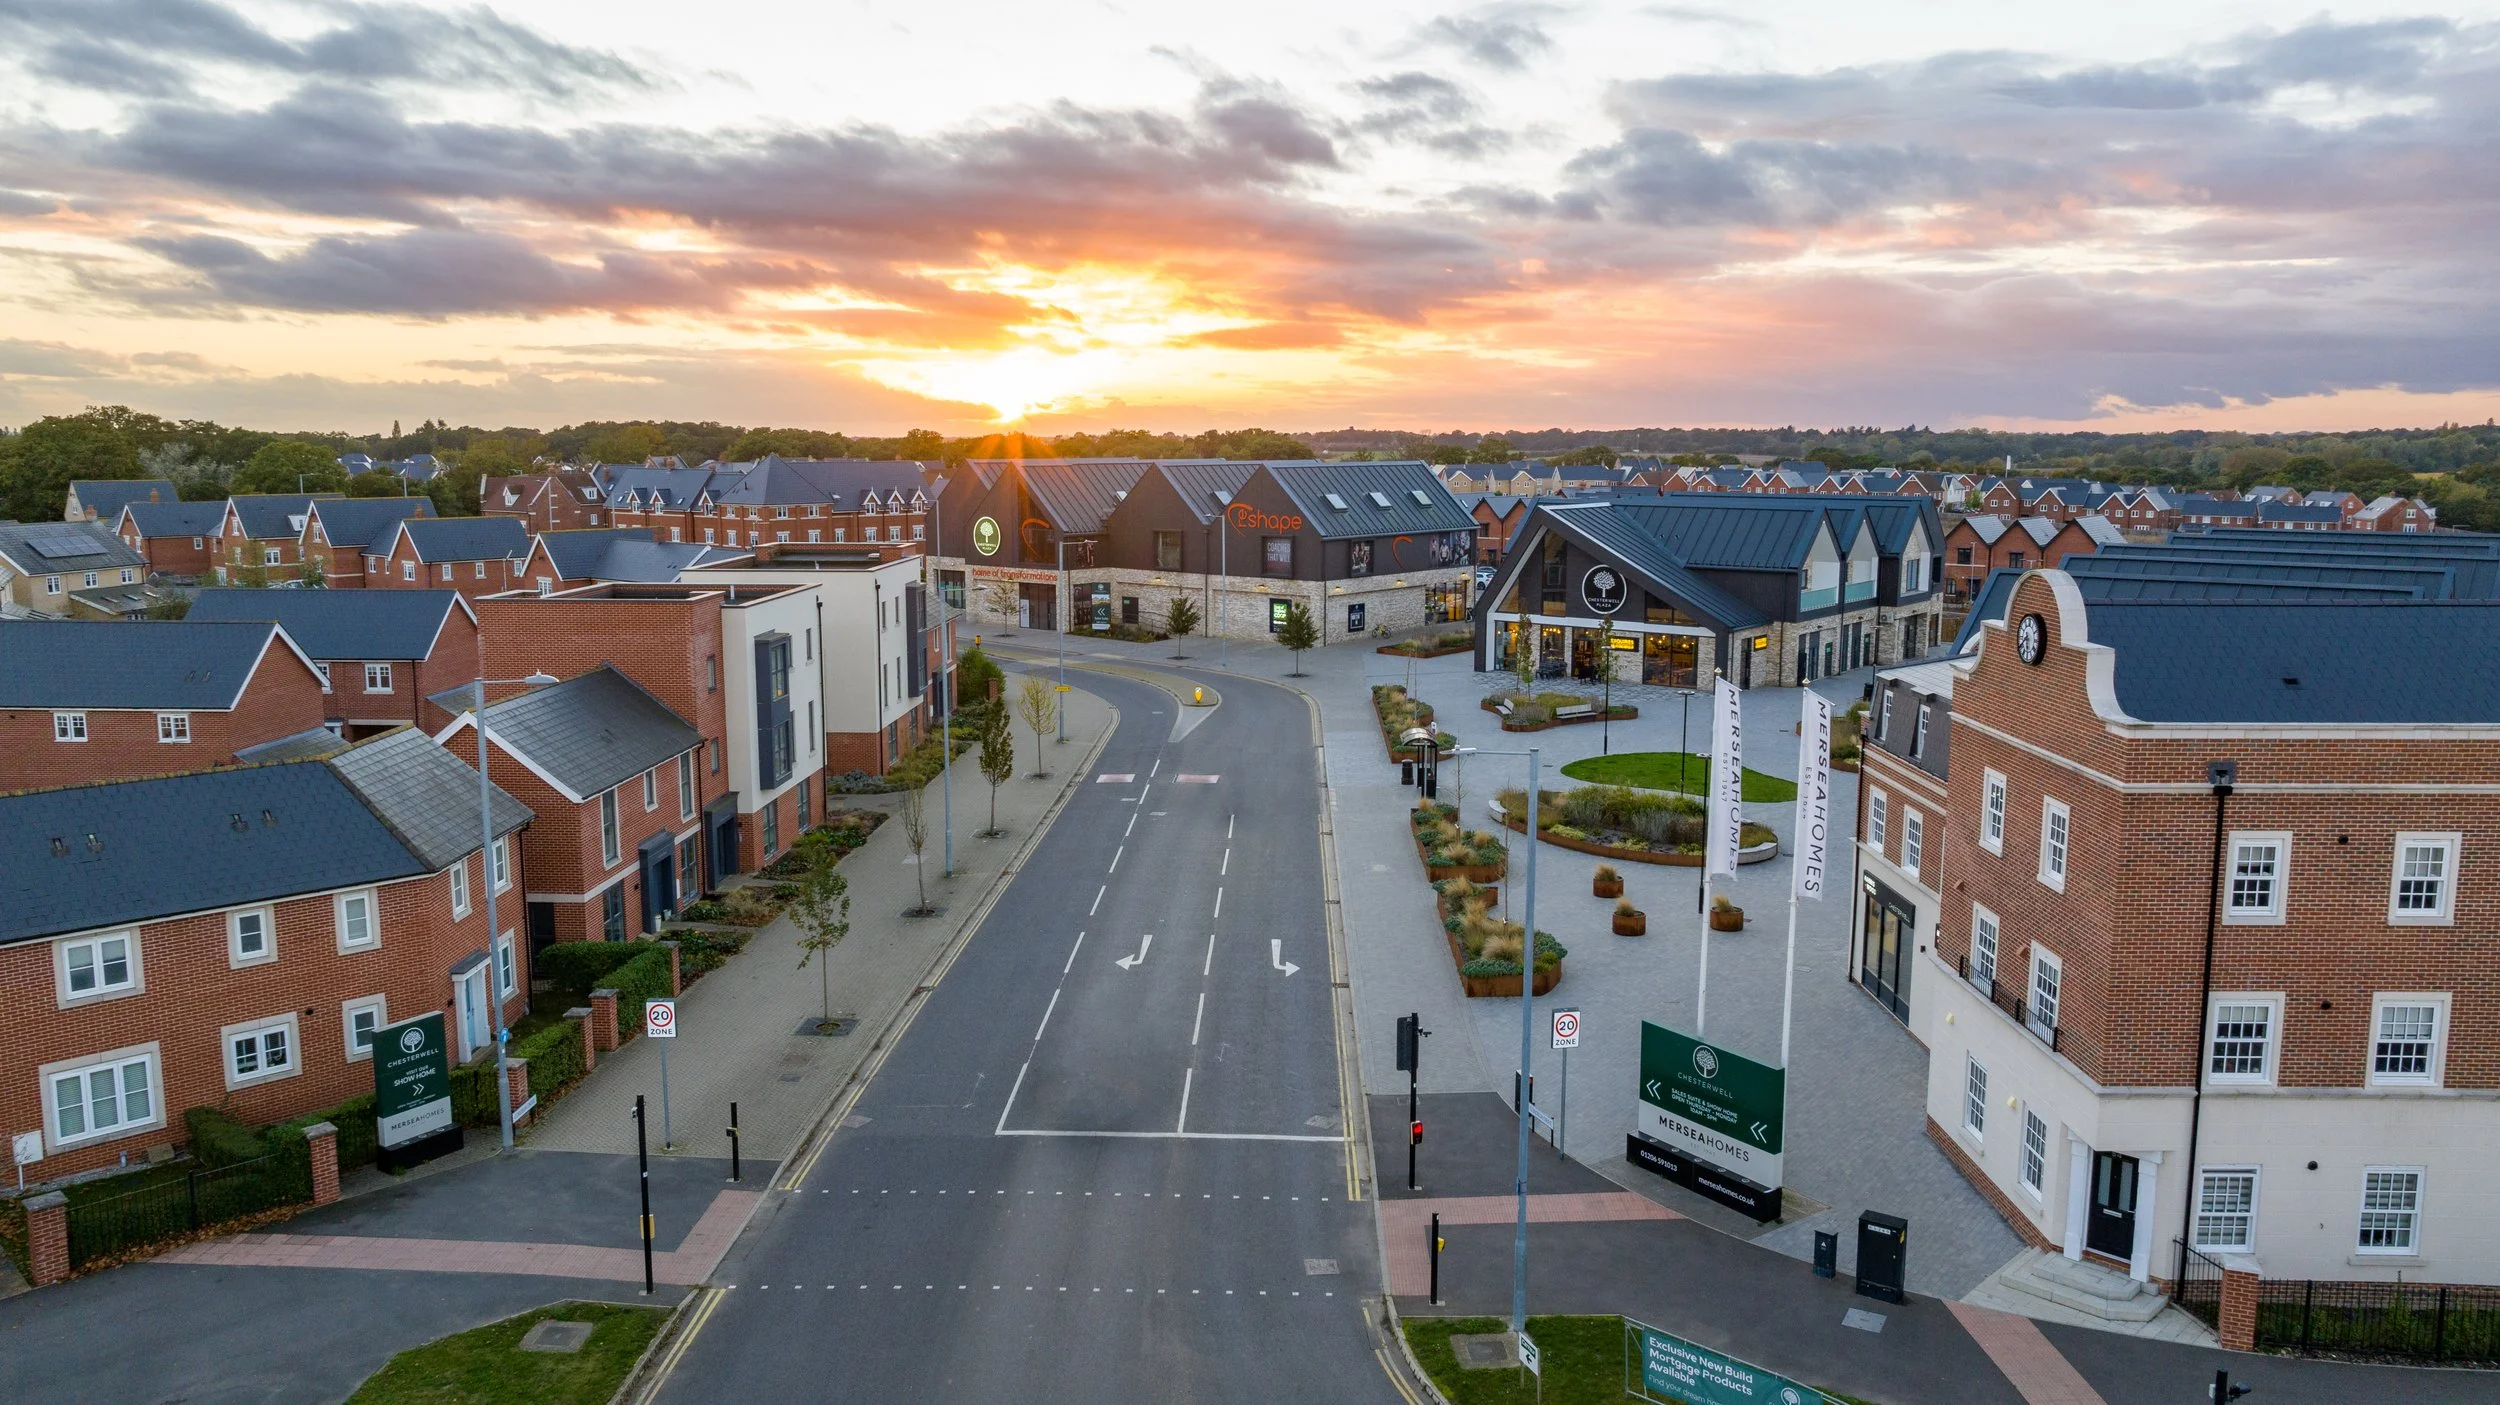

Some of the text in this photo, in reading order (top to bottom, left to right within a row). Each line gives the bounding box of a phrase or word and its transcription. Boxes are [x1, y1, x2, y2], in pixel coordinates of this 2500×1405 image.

[1267, 542, 1291, 553] COACHES
[972, 567, 1057, 580] home of transformations
[1804, 700, 1829, 893] MERSEAHOMES
[652, 1010, 669, 1021] 20
[1559, 1020, 1575, 1031] 20
[1555, 1038, 1577, 1046] ZONE
[387, 1047, 440, 1068] CHESTERWELL
[394, 1067, 436, 1087] SHOW HOME
[406, 1068, 418, 1076] VISIT
[1677, 1071, 1733, 1099] CHESTERWELL
[1671, 1088, 1687, 1098] SALES
[1687, 1093, 1701, 1104] SUITE
[1706, 1101, 1722, 1112] SHOW
[1722, 1108, 1738, 1119] HOME
[1671, 1094, 1685, 1104] OPEN
[1686, 1099, 1712, 1115] THURSDAY
[1715, 1111, 1738, 1124] MONDAY
[1690, 1107, 1703, 1117] 10AM
[1706, 1114, 1718, 1123] 5PM
[391, 1107, 445, 1131] MERSEAHOMES
[1659, 1115, 1750, 1162] MERSEAHOMES
[1640, 1149, 1658, 1163] 01206
[1698, 1177, 1755, 1207] merseahomes.co.uk
[1649, 1336, 1753, 1384] Exclusive New Build
[1649, 1348, 1753, 1396] Mortgage Products
[1649, 1360, 1696, 1386] Available
[1648, 1374, 1665, 1387] Find
[1665, 1381, 1682, 1392] your
[1682, 1387, 1706, 1403] dream
